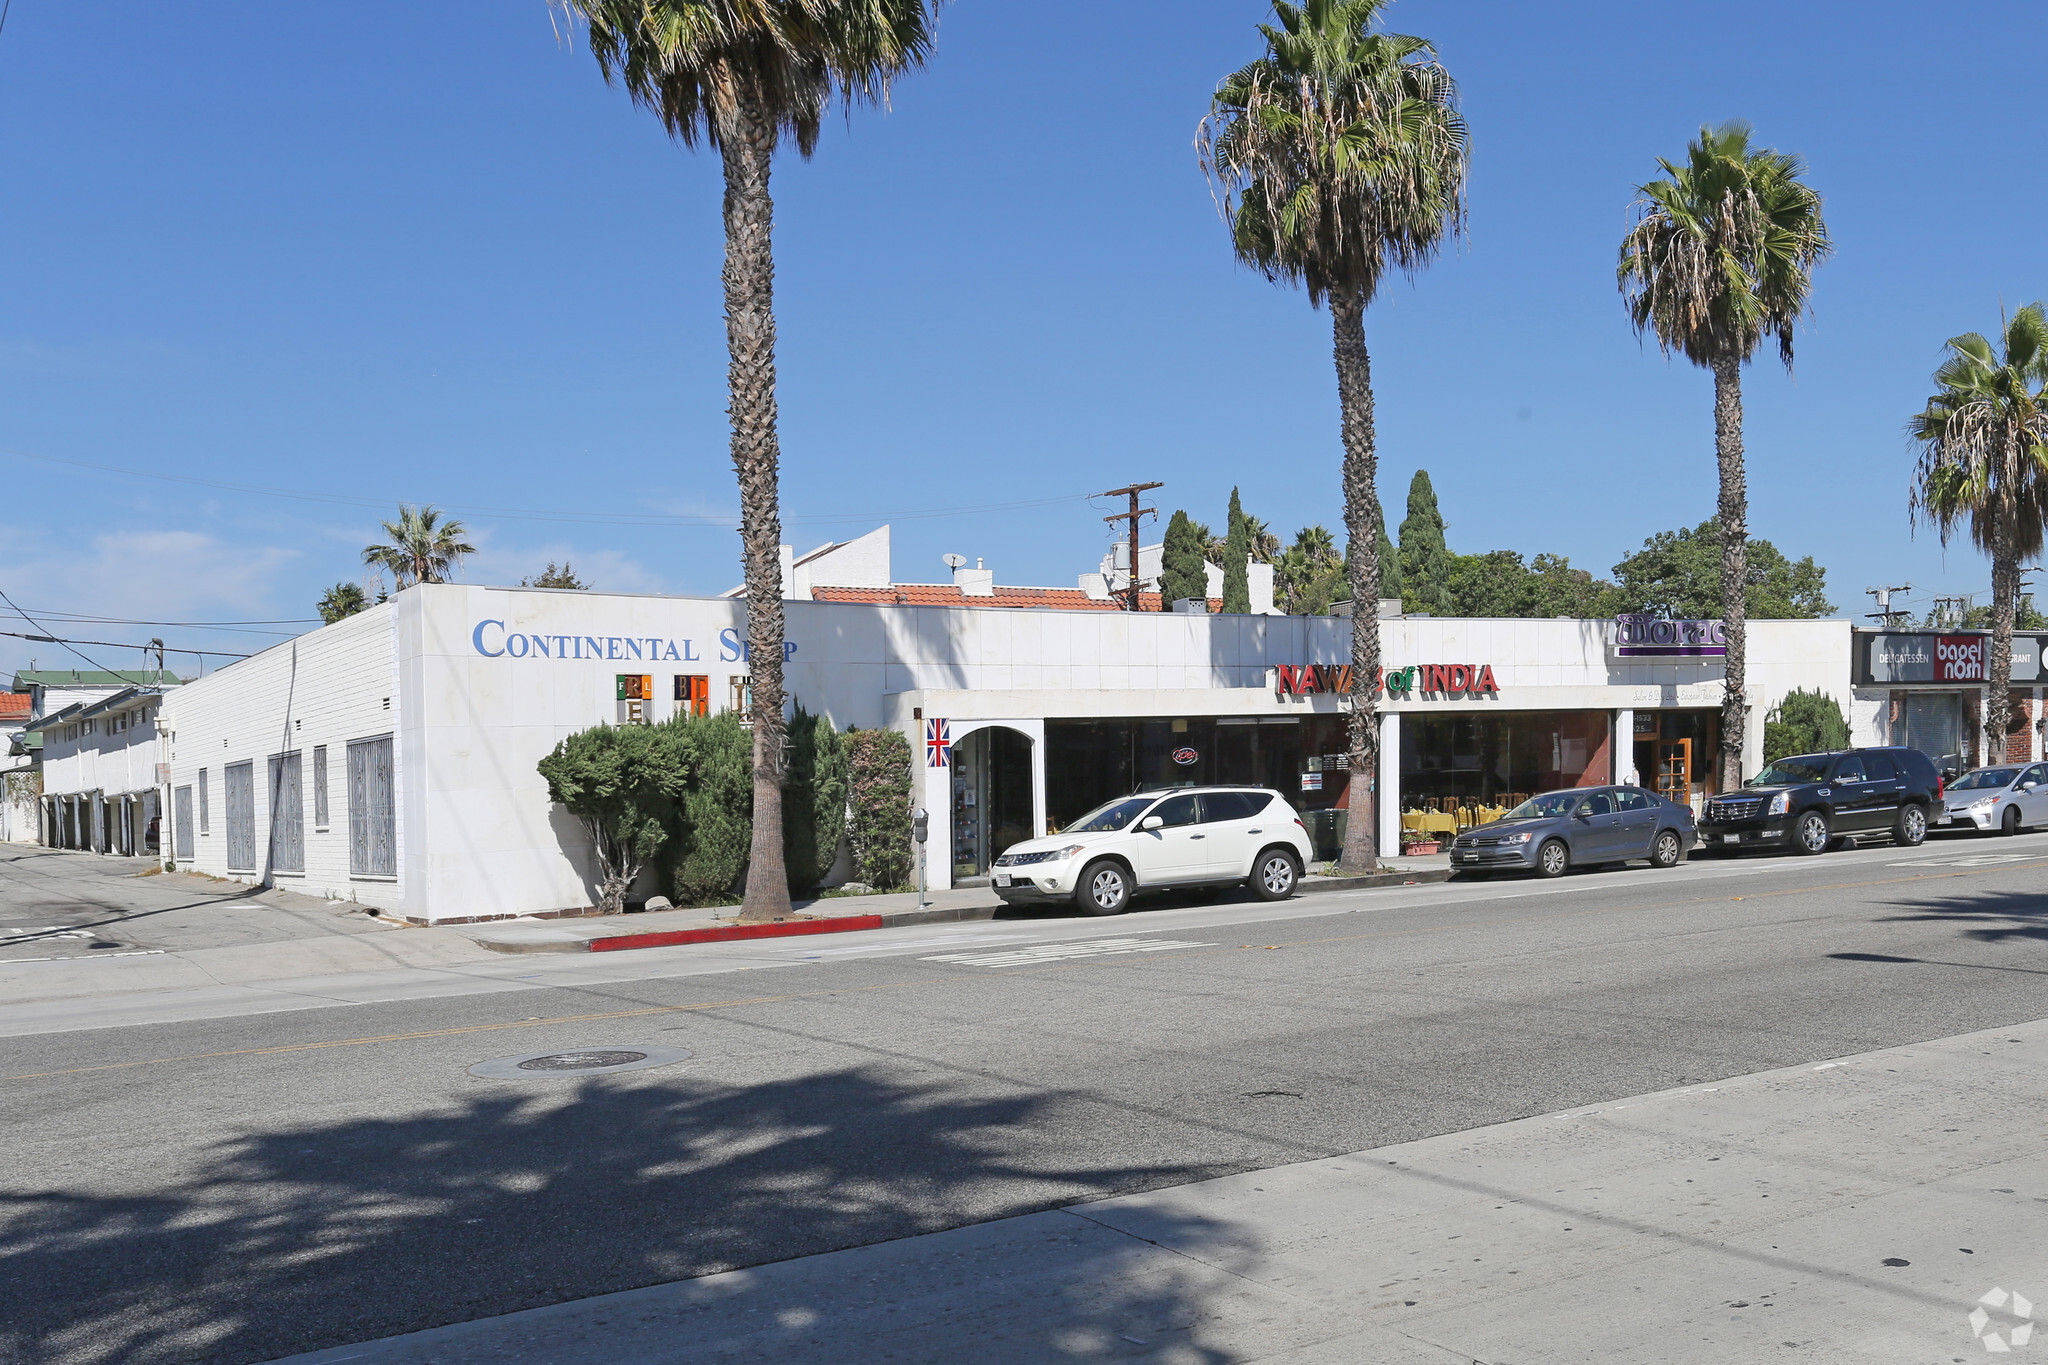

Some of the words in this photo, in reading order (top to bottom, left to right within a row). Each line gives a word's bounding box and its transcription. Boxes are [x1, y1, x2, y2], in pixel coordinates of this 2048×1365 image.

[719, 627, 798, 663] SP
[1936, 637, 1982, 662] bagel
[1879, 653, 1929, 664] DELICATESSEN
[1387, 666, 1416, 692] of
[1420, 664, 1501, 692] INDIA
